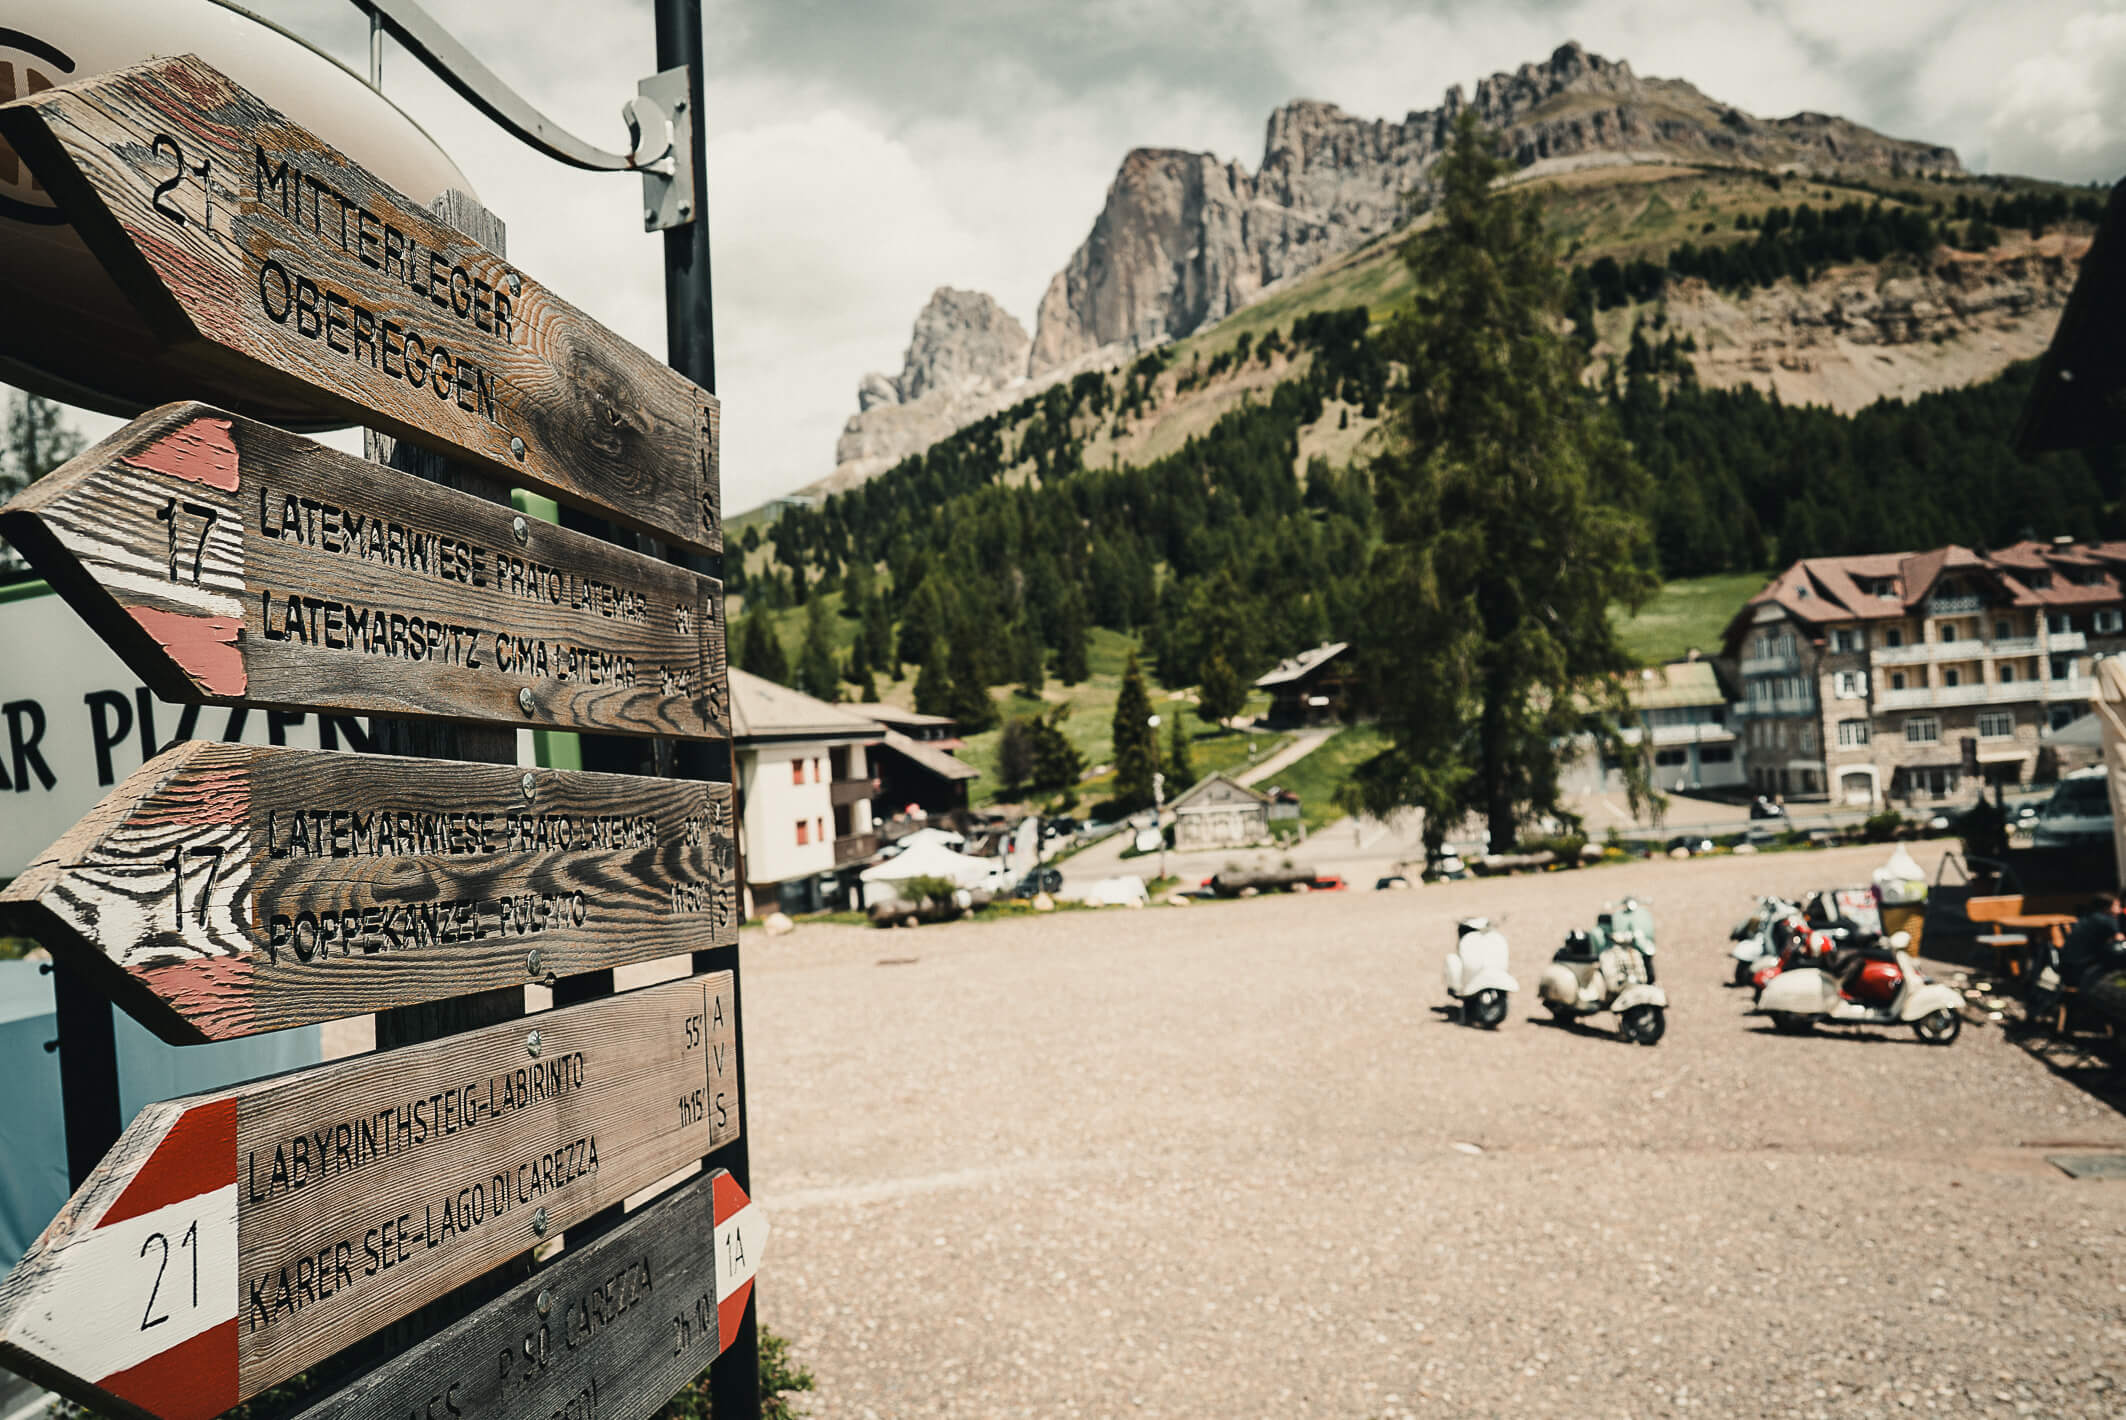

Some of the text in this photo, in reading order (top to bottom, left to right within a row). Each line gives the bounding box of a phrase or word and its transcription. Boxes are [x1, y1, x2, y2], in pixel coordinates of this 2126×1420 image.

[152, 133, 213, 241] 21
[255, 143, 513, 345] MITTERLEGER
[259, 259, 496, 422] OBEREGGEN
[156, 496, 218, 588] 17
[260, 486, 488, 588] LATEMARWIESE
[496, 553, 563, 606] PRATO
[569, 574, 649, 625] LATEMAR
[262, 589, 482, 669] LATEMARSPITZ
[496, 632, 550, 679] CIMA
[555, 643, 637, 690] LATEMAR
[268, 808, 496, 859] LATEMARWIESE
[506, 813, 573, 852] PRATO
[579, 815, 658, 850] LATEMAR
[163, 845, 226, 933] 17
[270, 900, 488, 966] POPPEKANZEL
[140, 1219, 198, 1332] 21
[250, 1238, 354, 1334] KARER
[492, 1173, 512, 1217] DI
[517, 1134, 601, 1205] CAREZZA
[725, 1226, 747, 1278] 1A
[565, 1255, 654, 1352] CAREZZA
